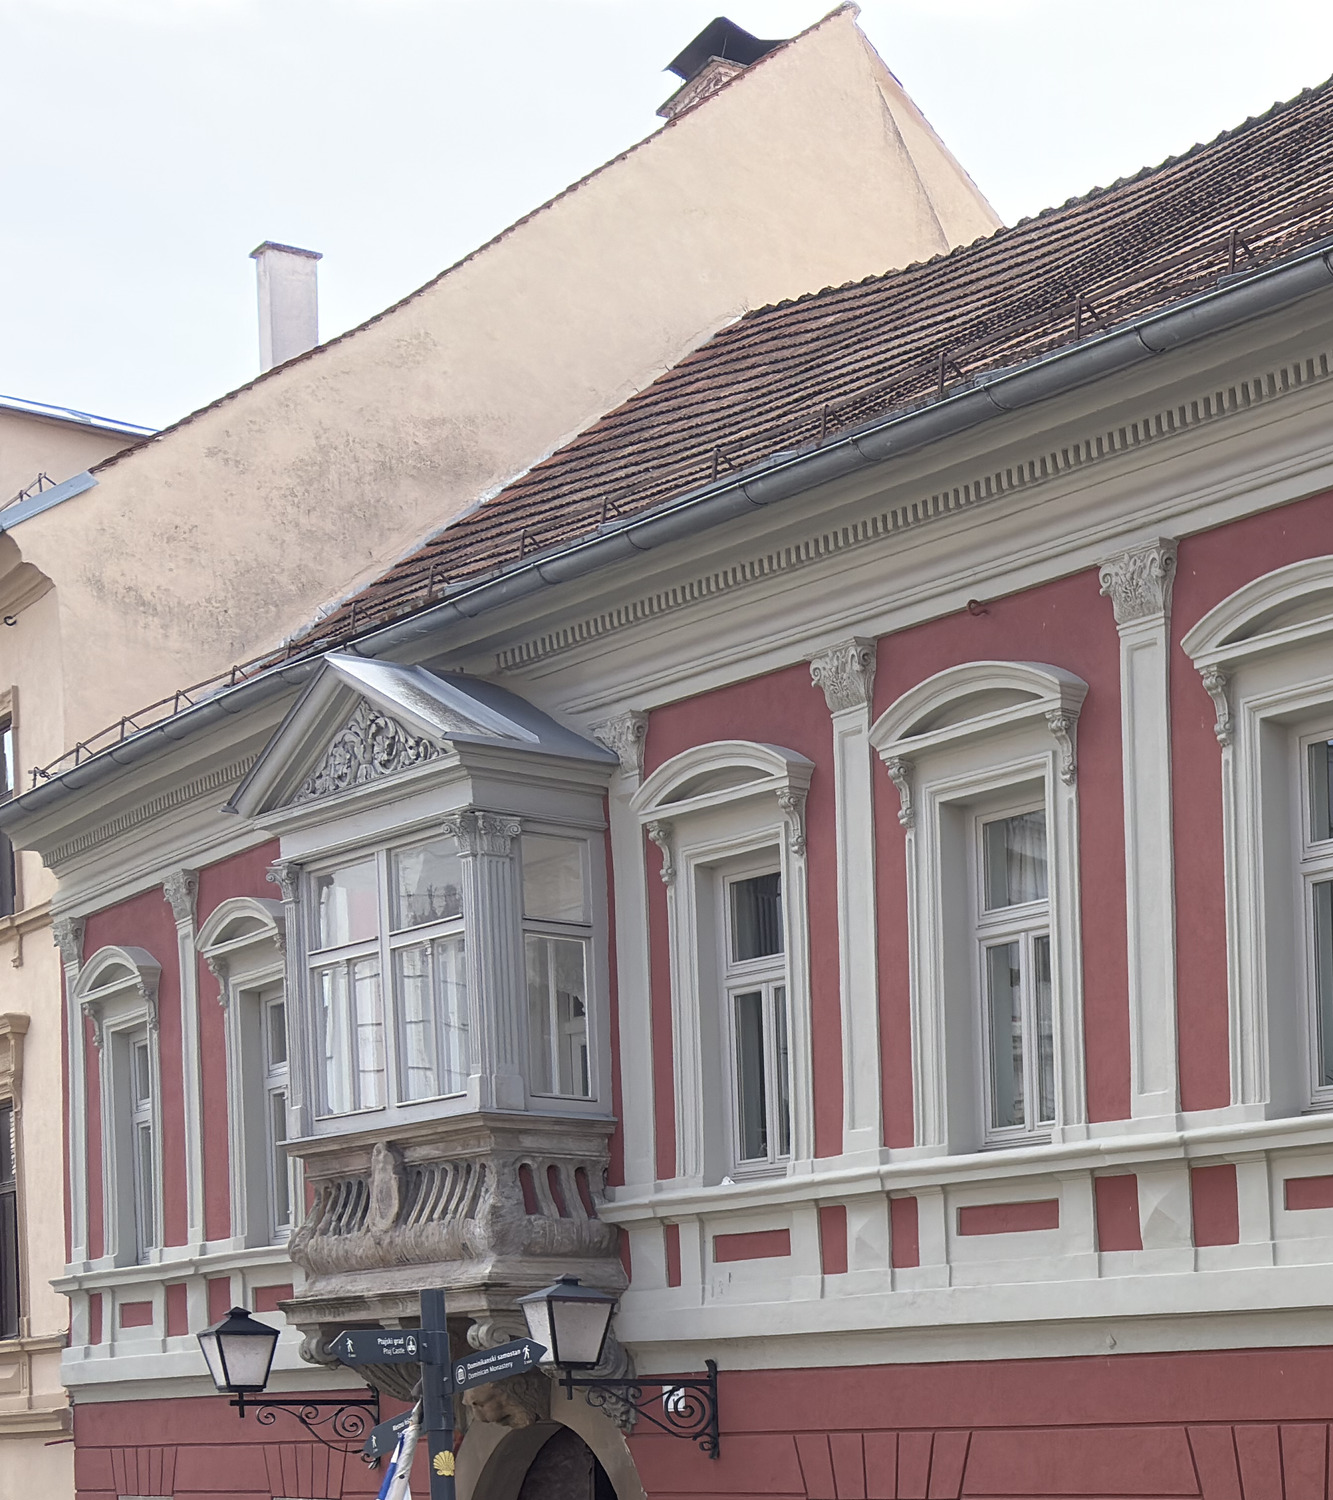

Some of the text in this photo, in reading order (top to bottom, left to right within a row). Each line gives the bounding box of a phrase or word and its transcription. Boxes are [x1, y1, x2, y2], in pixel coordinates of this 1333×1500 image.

[497, 1349, 521, 1361] samostan
[468, 1368, 489, 1379] Dominican
[489, 1361, 513, 1372] Monastery
